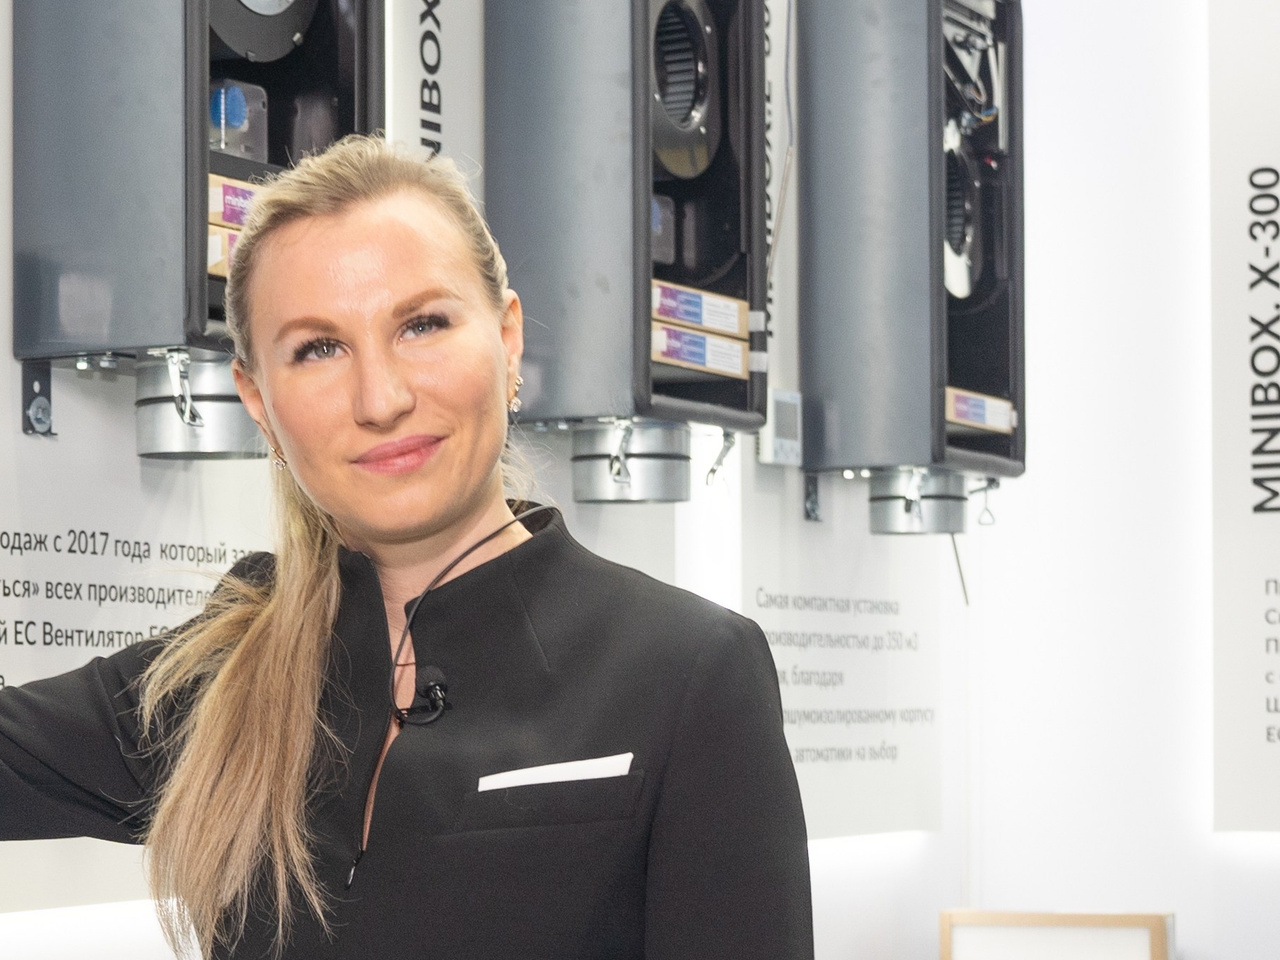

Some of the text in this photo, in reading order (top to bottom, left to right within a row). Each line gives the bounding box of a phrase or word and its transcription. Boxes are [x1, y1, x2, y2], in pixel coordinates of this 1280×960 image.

[1249, 167, 1280, 290] X-300
[53, 536, 62, 553] с
[67, 529, 110, 557] 2017
[114, 538, 150, 560] года
[159, 541, 227, 567] который
[45, 580, 83, 602] всех
[756, 587, 899, 618] Самая компактная установка
[791, 664, 844, 691] благодаря
